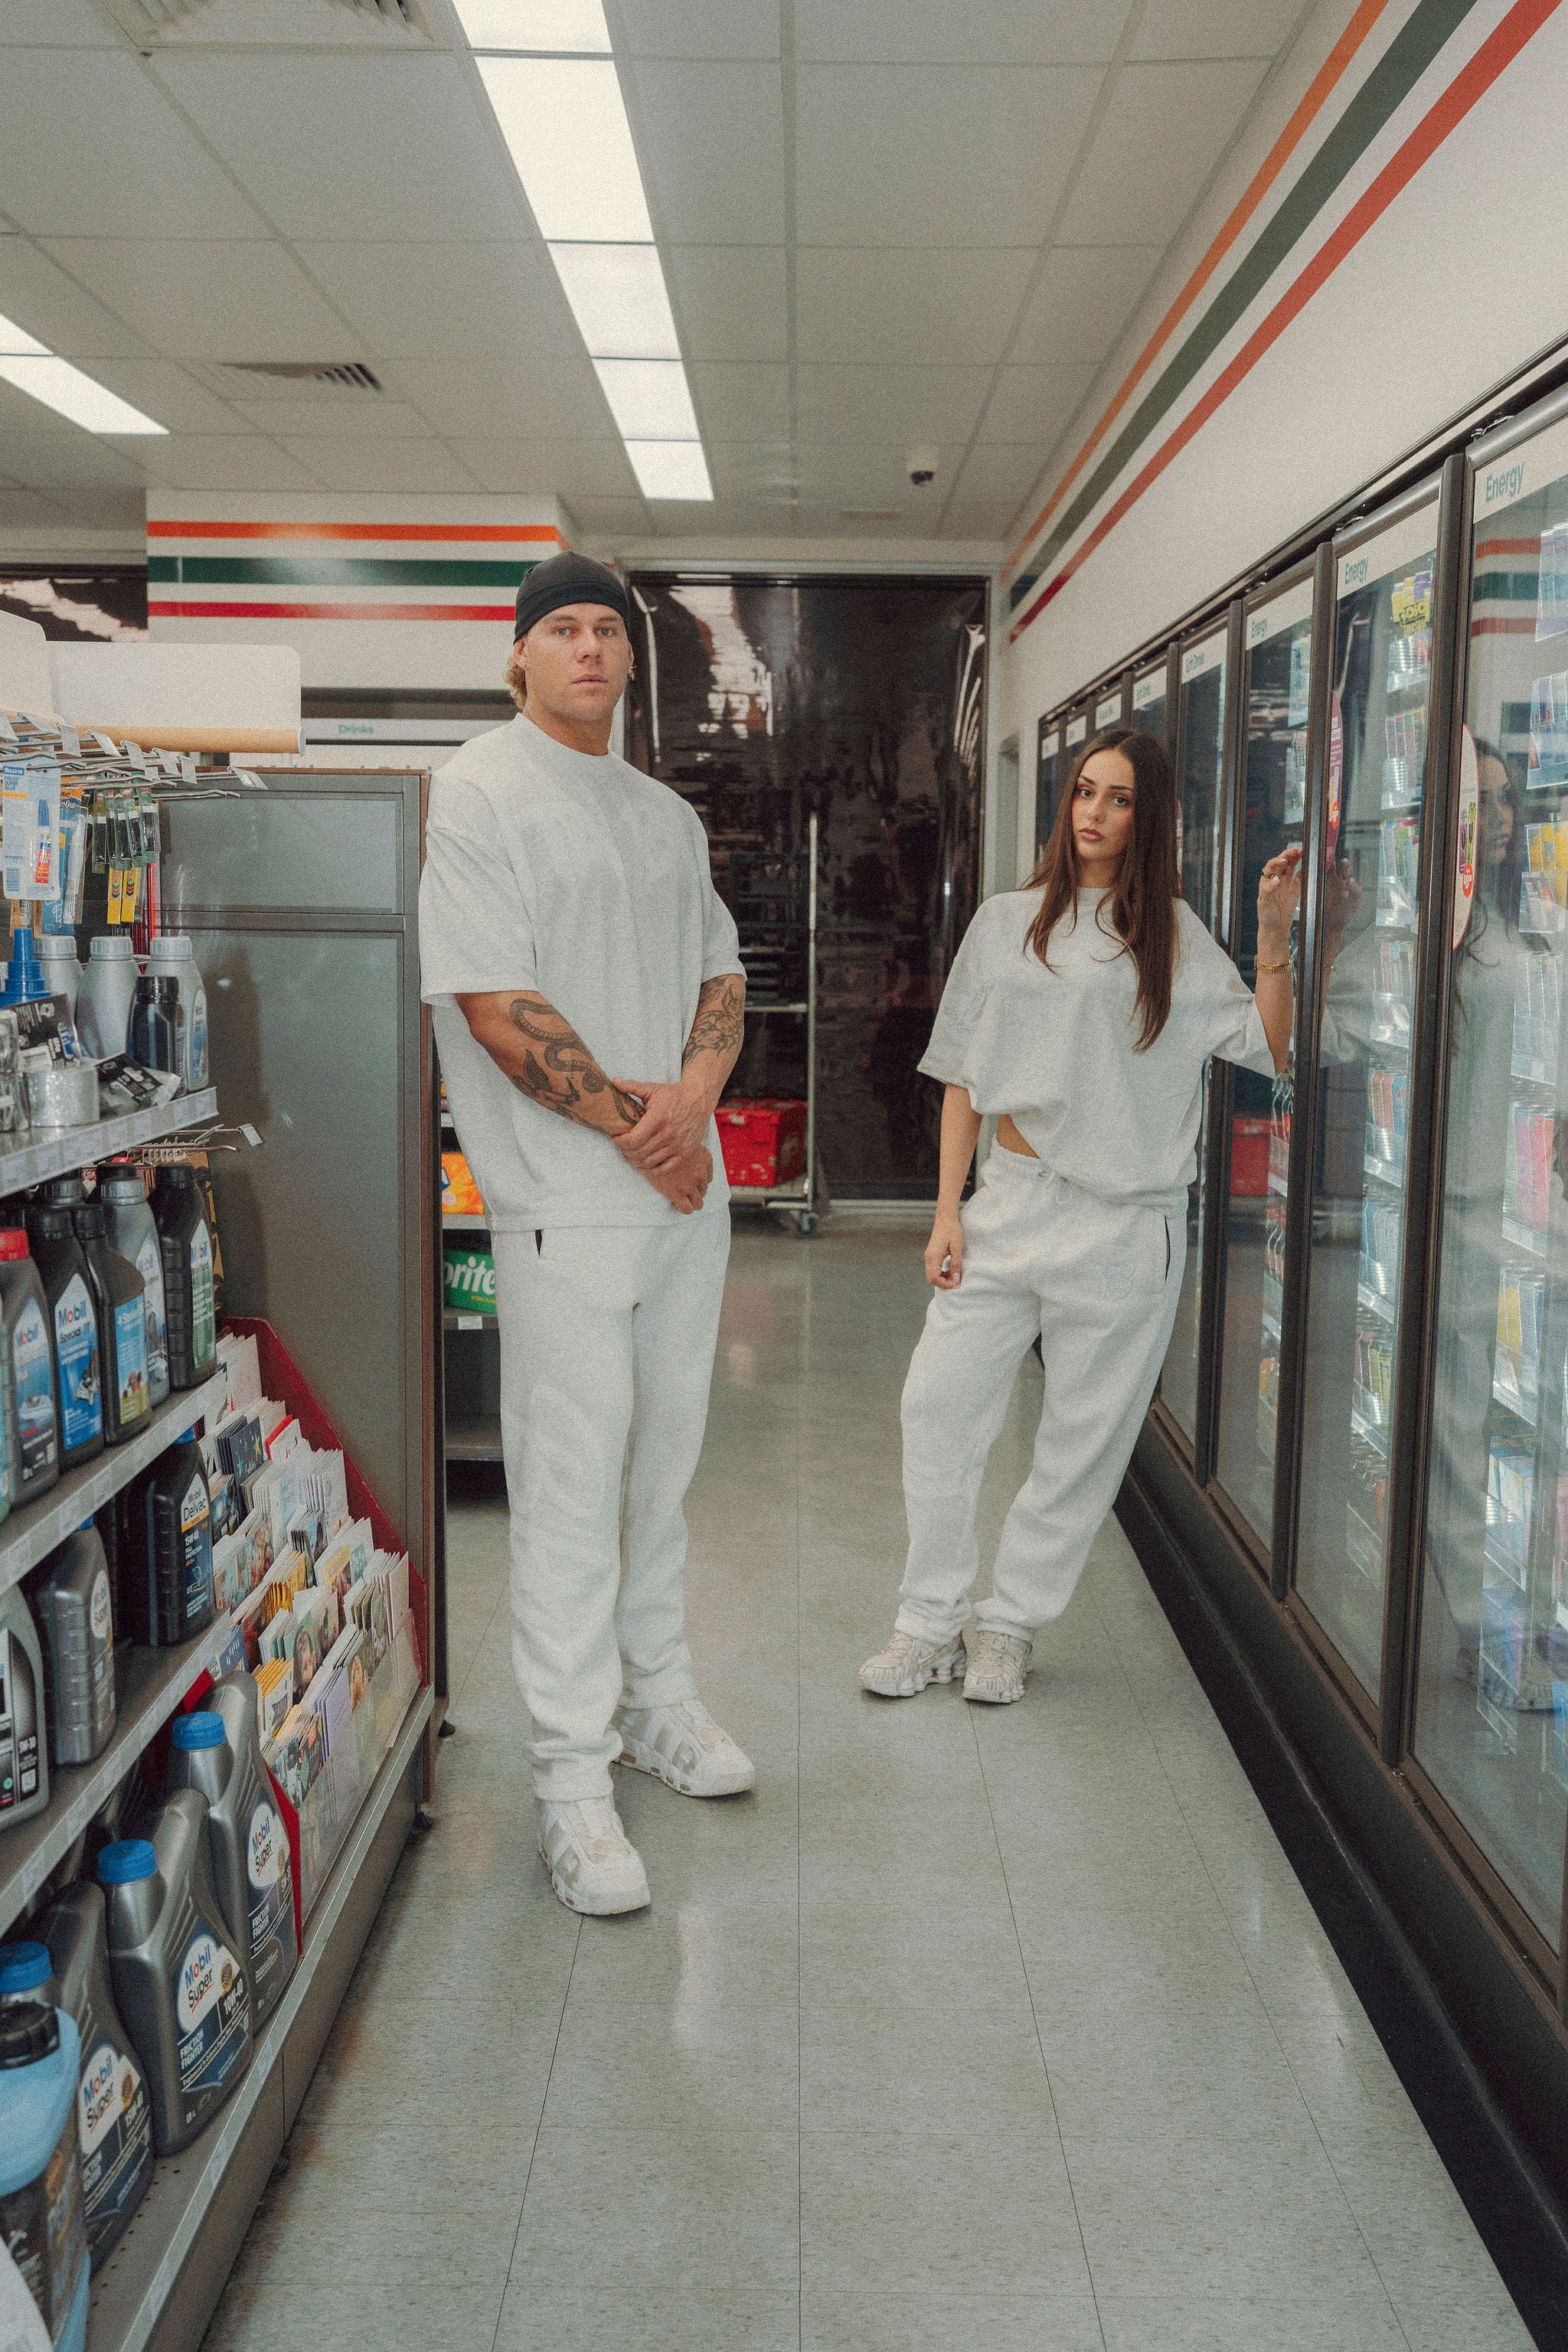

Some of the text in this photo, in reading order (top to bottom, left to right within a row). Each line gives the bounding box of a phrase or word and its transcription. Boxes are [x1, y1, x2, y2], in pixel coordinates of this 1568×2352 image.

[1485, 461, 1525, 503] Energy
[1344, 557, 1369, 586] Energy
[1250, 617, 1268, 639] Energy
[58, 1300, 87, 1328] Mobil
[183, 1498, 207, 1522] Delvac
[251, 1815, 272, 1854] Mobil
[255, 1839, 273, 1873] Super
[185, 1944, 211, 1989] Mobil
[188, 1968, 214, 2008] Super
[223, 1977, 244, 2015] 10W-40
[179, 2027, 204, 2060] FRICTION
[181, 2040, 204, 2070] FIGHTER
[83, 2053, 113, 2107] Mobil
[87, 2081, 114, 2128] Super
